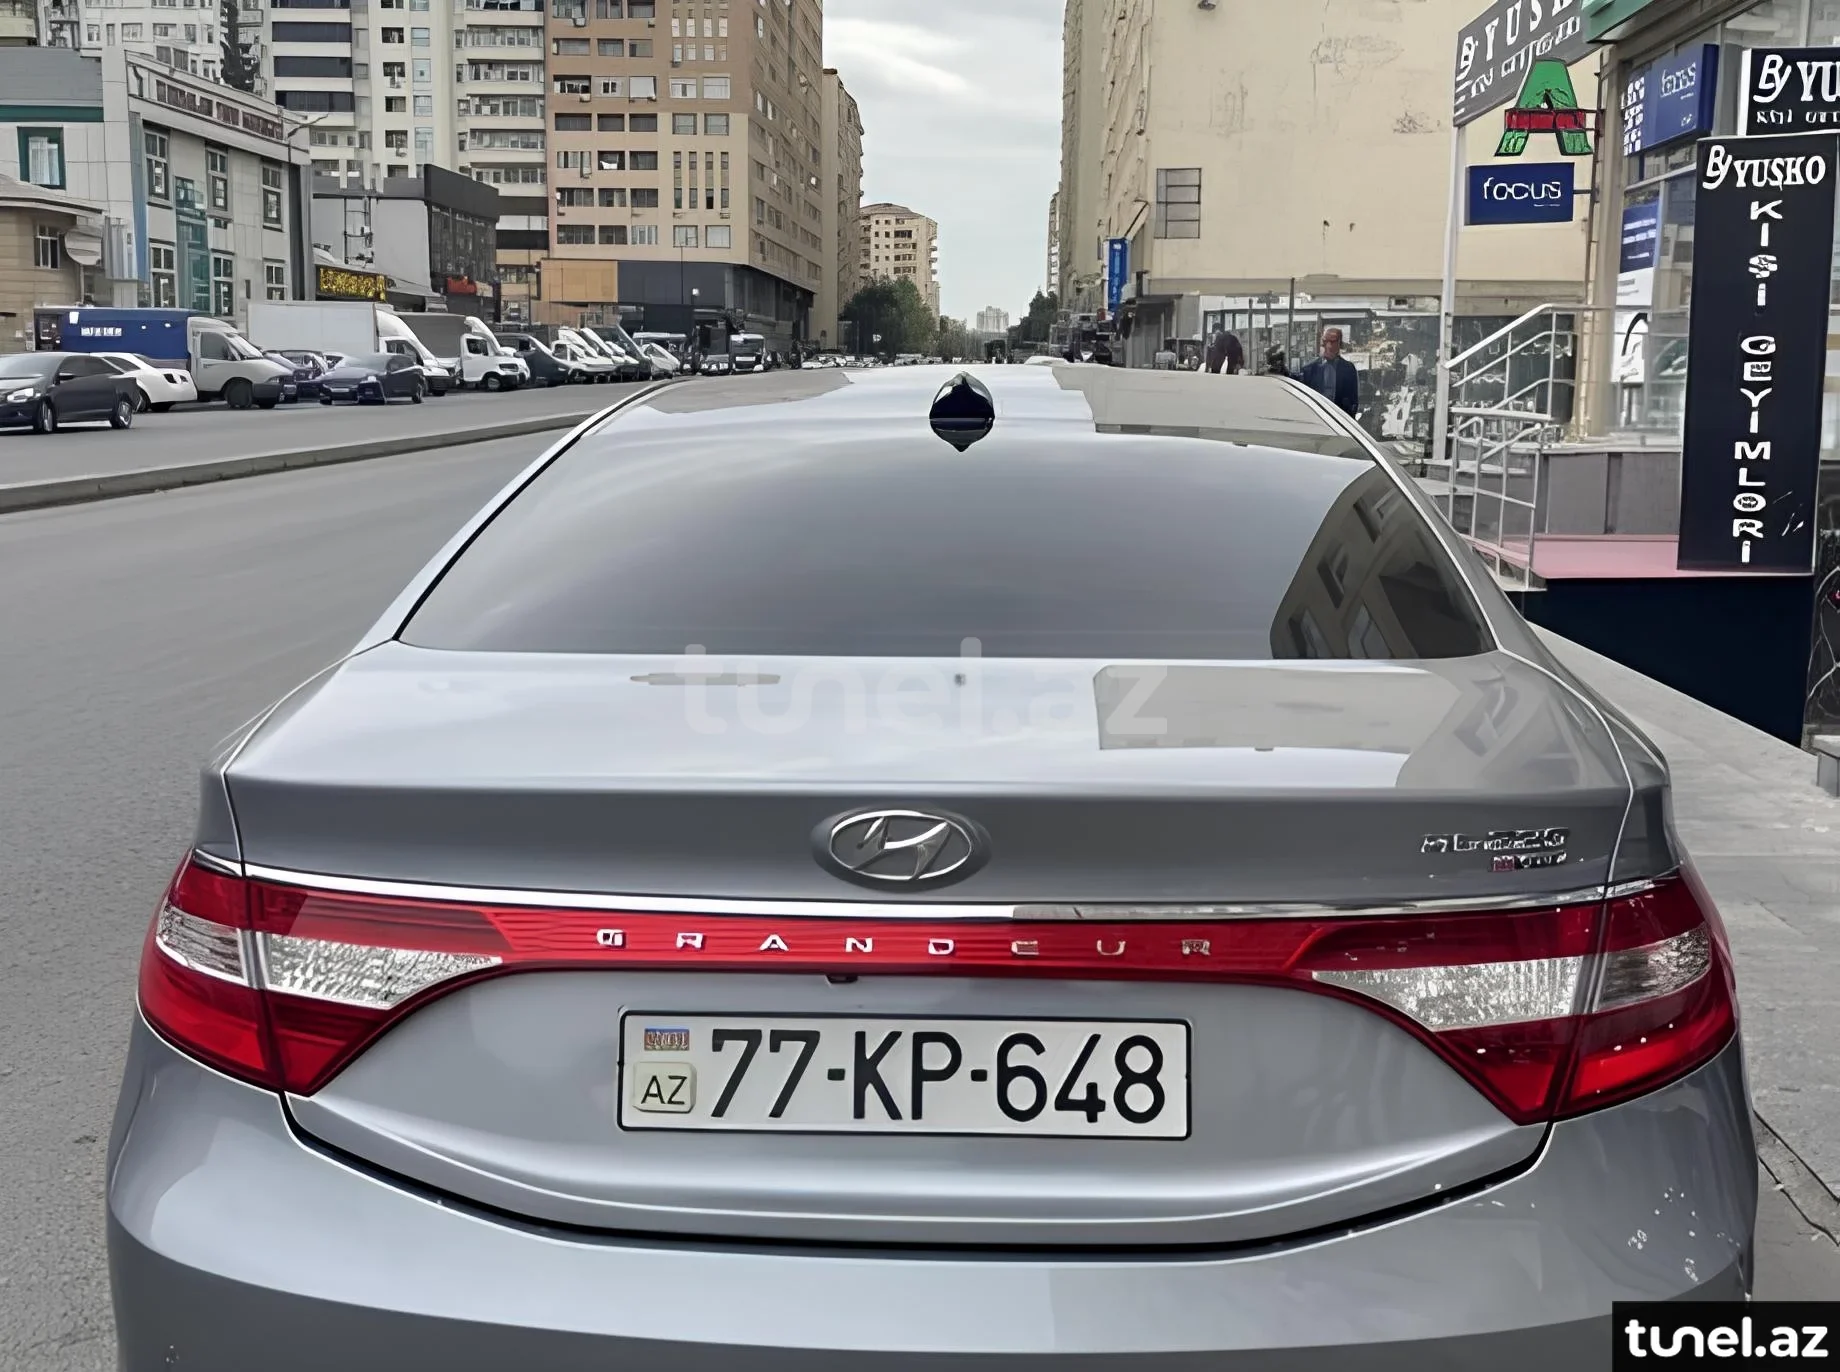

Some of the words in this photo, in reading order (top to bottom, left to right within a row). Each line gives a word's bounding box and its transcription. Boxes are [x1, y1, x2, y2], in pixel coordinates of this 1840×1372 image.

[1752, 54, 1792, 103] By
[1702, 145, 1733, 190] By
[1733, 156, 1826, 191] YUSKO
[1484, 177, 1561, 200] focus
[597, 928, 1211, 955] GRANDEUR
[641, 1076, 687, 1105] AZ
[711, 1029, 1164, 1123] 77-KP-648
